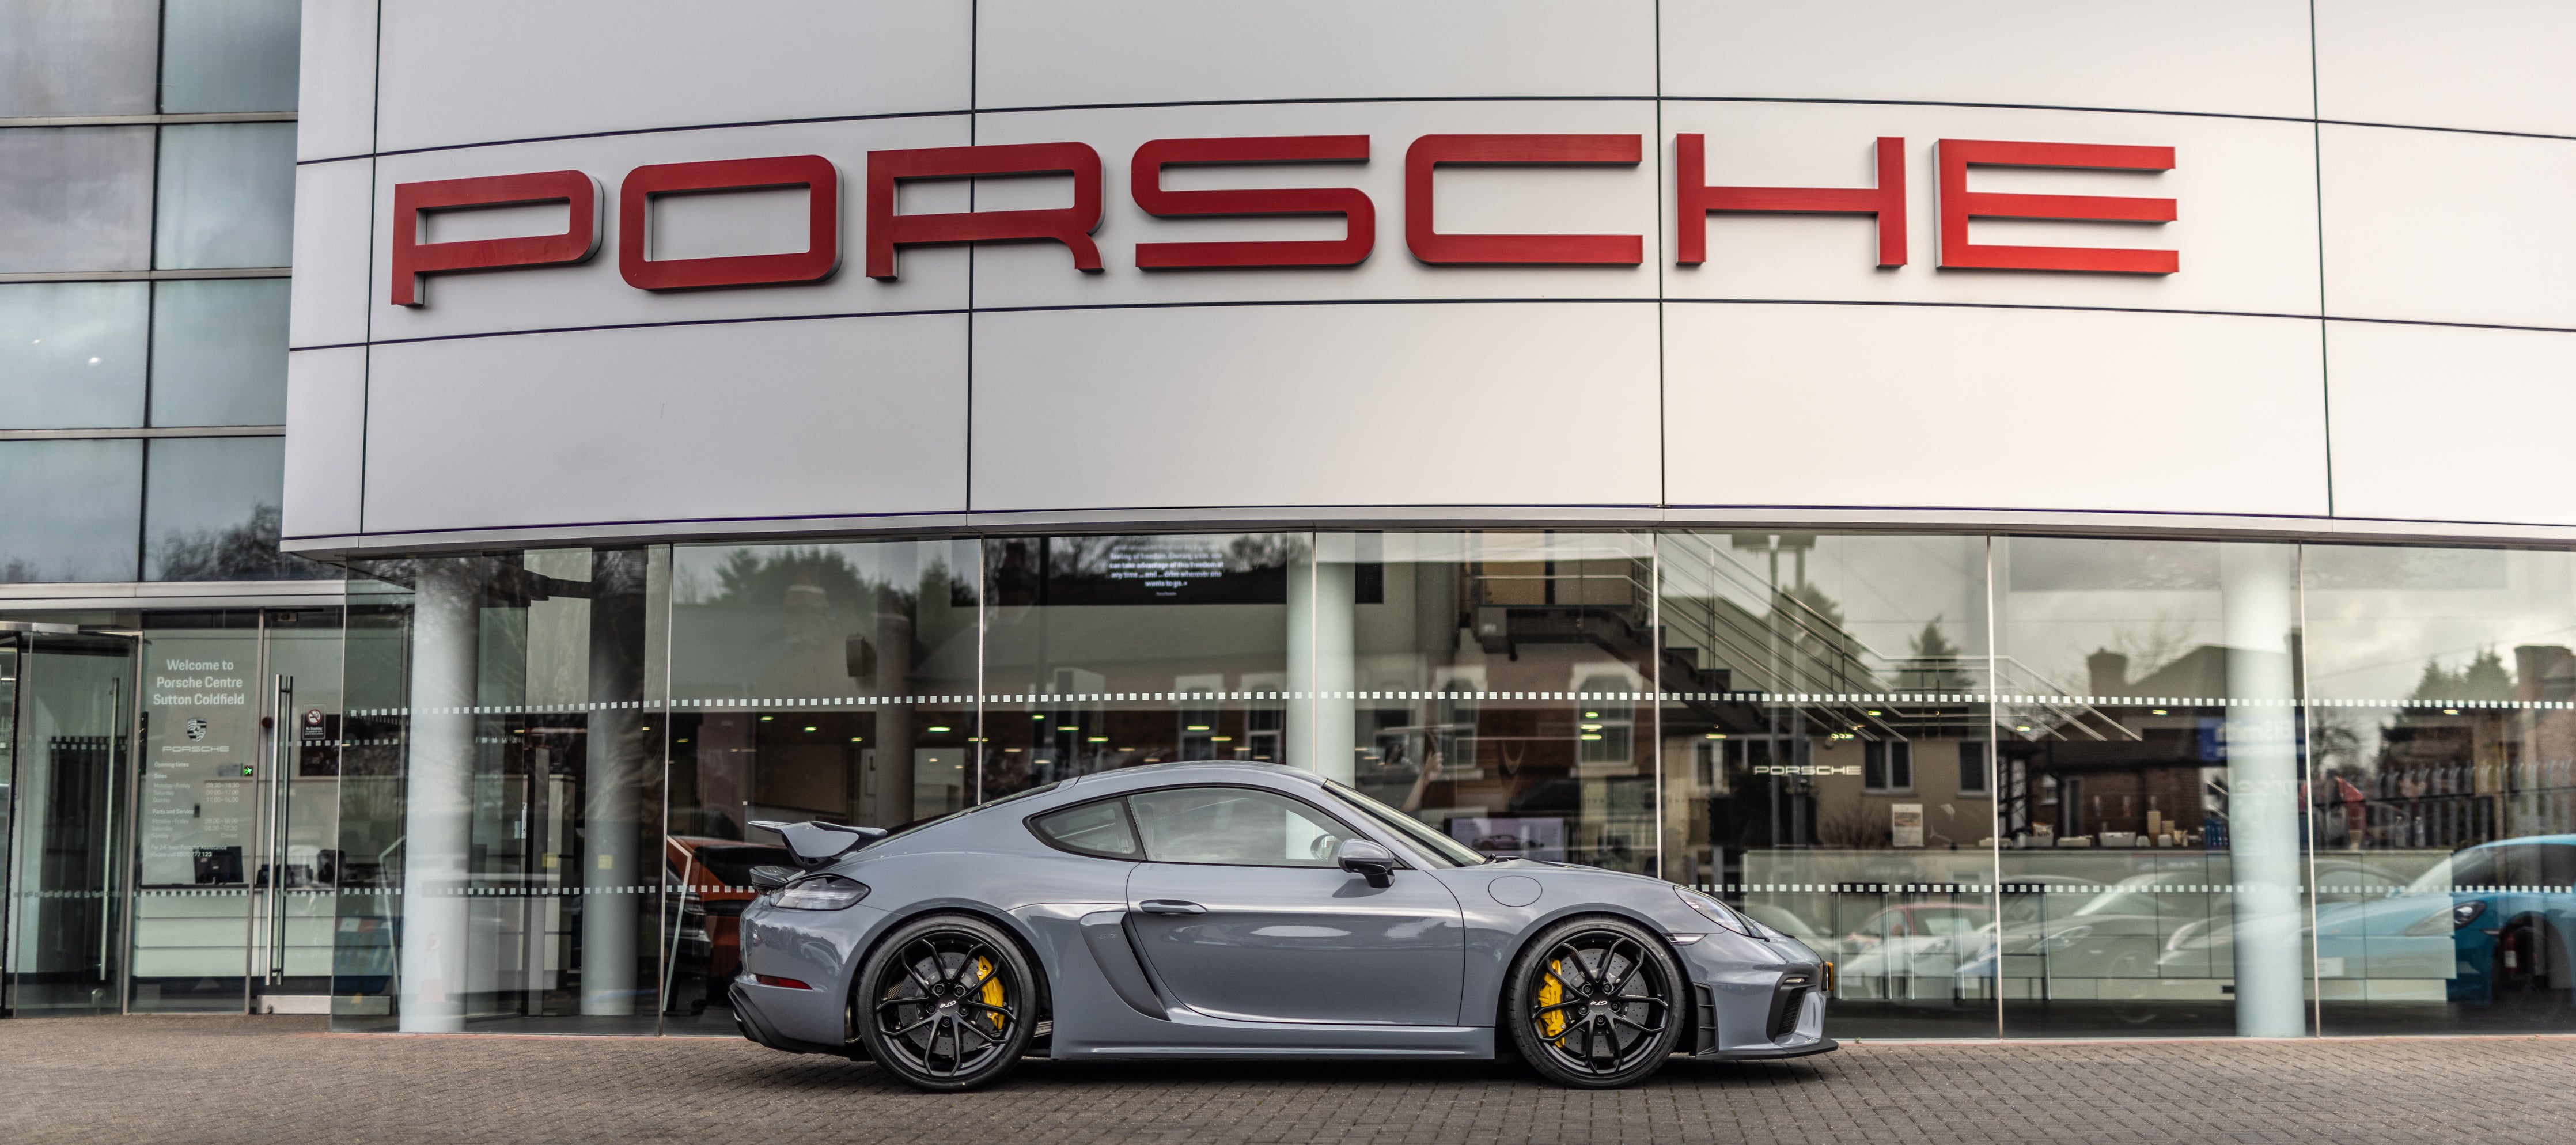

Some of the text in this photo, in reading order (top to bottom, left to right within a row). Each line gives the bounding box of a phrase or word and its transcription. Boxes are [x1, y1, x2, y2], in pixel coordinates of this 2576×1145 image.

[392, 133, 2180, 308] PORSCHE
[166, 659, 234, 670] Welcome to
[157, 676, 243, 688] Porsche Centre
[153, 693, 244, 705] Sutton Coldfield
[1754, 765, 1862, 775] PORSCHE
[940, 1000, 957, 1008] GT4
